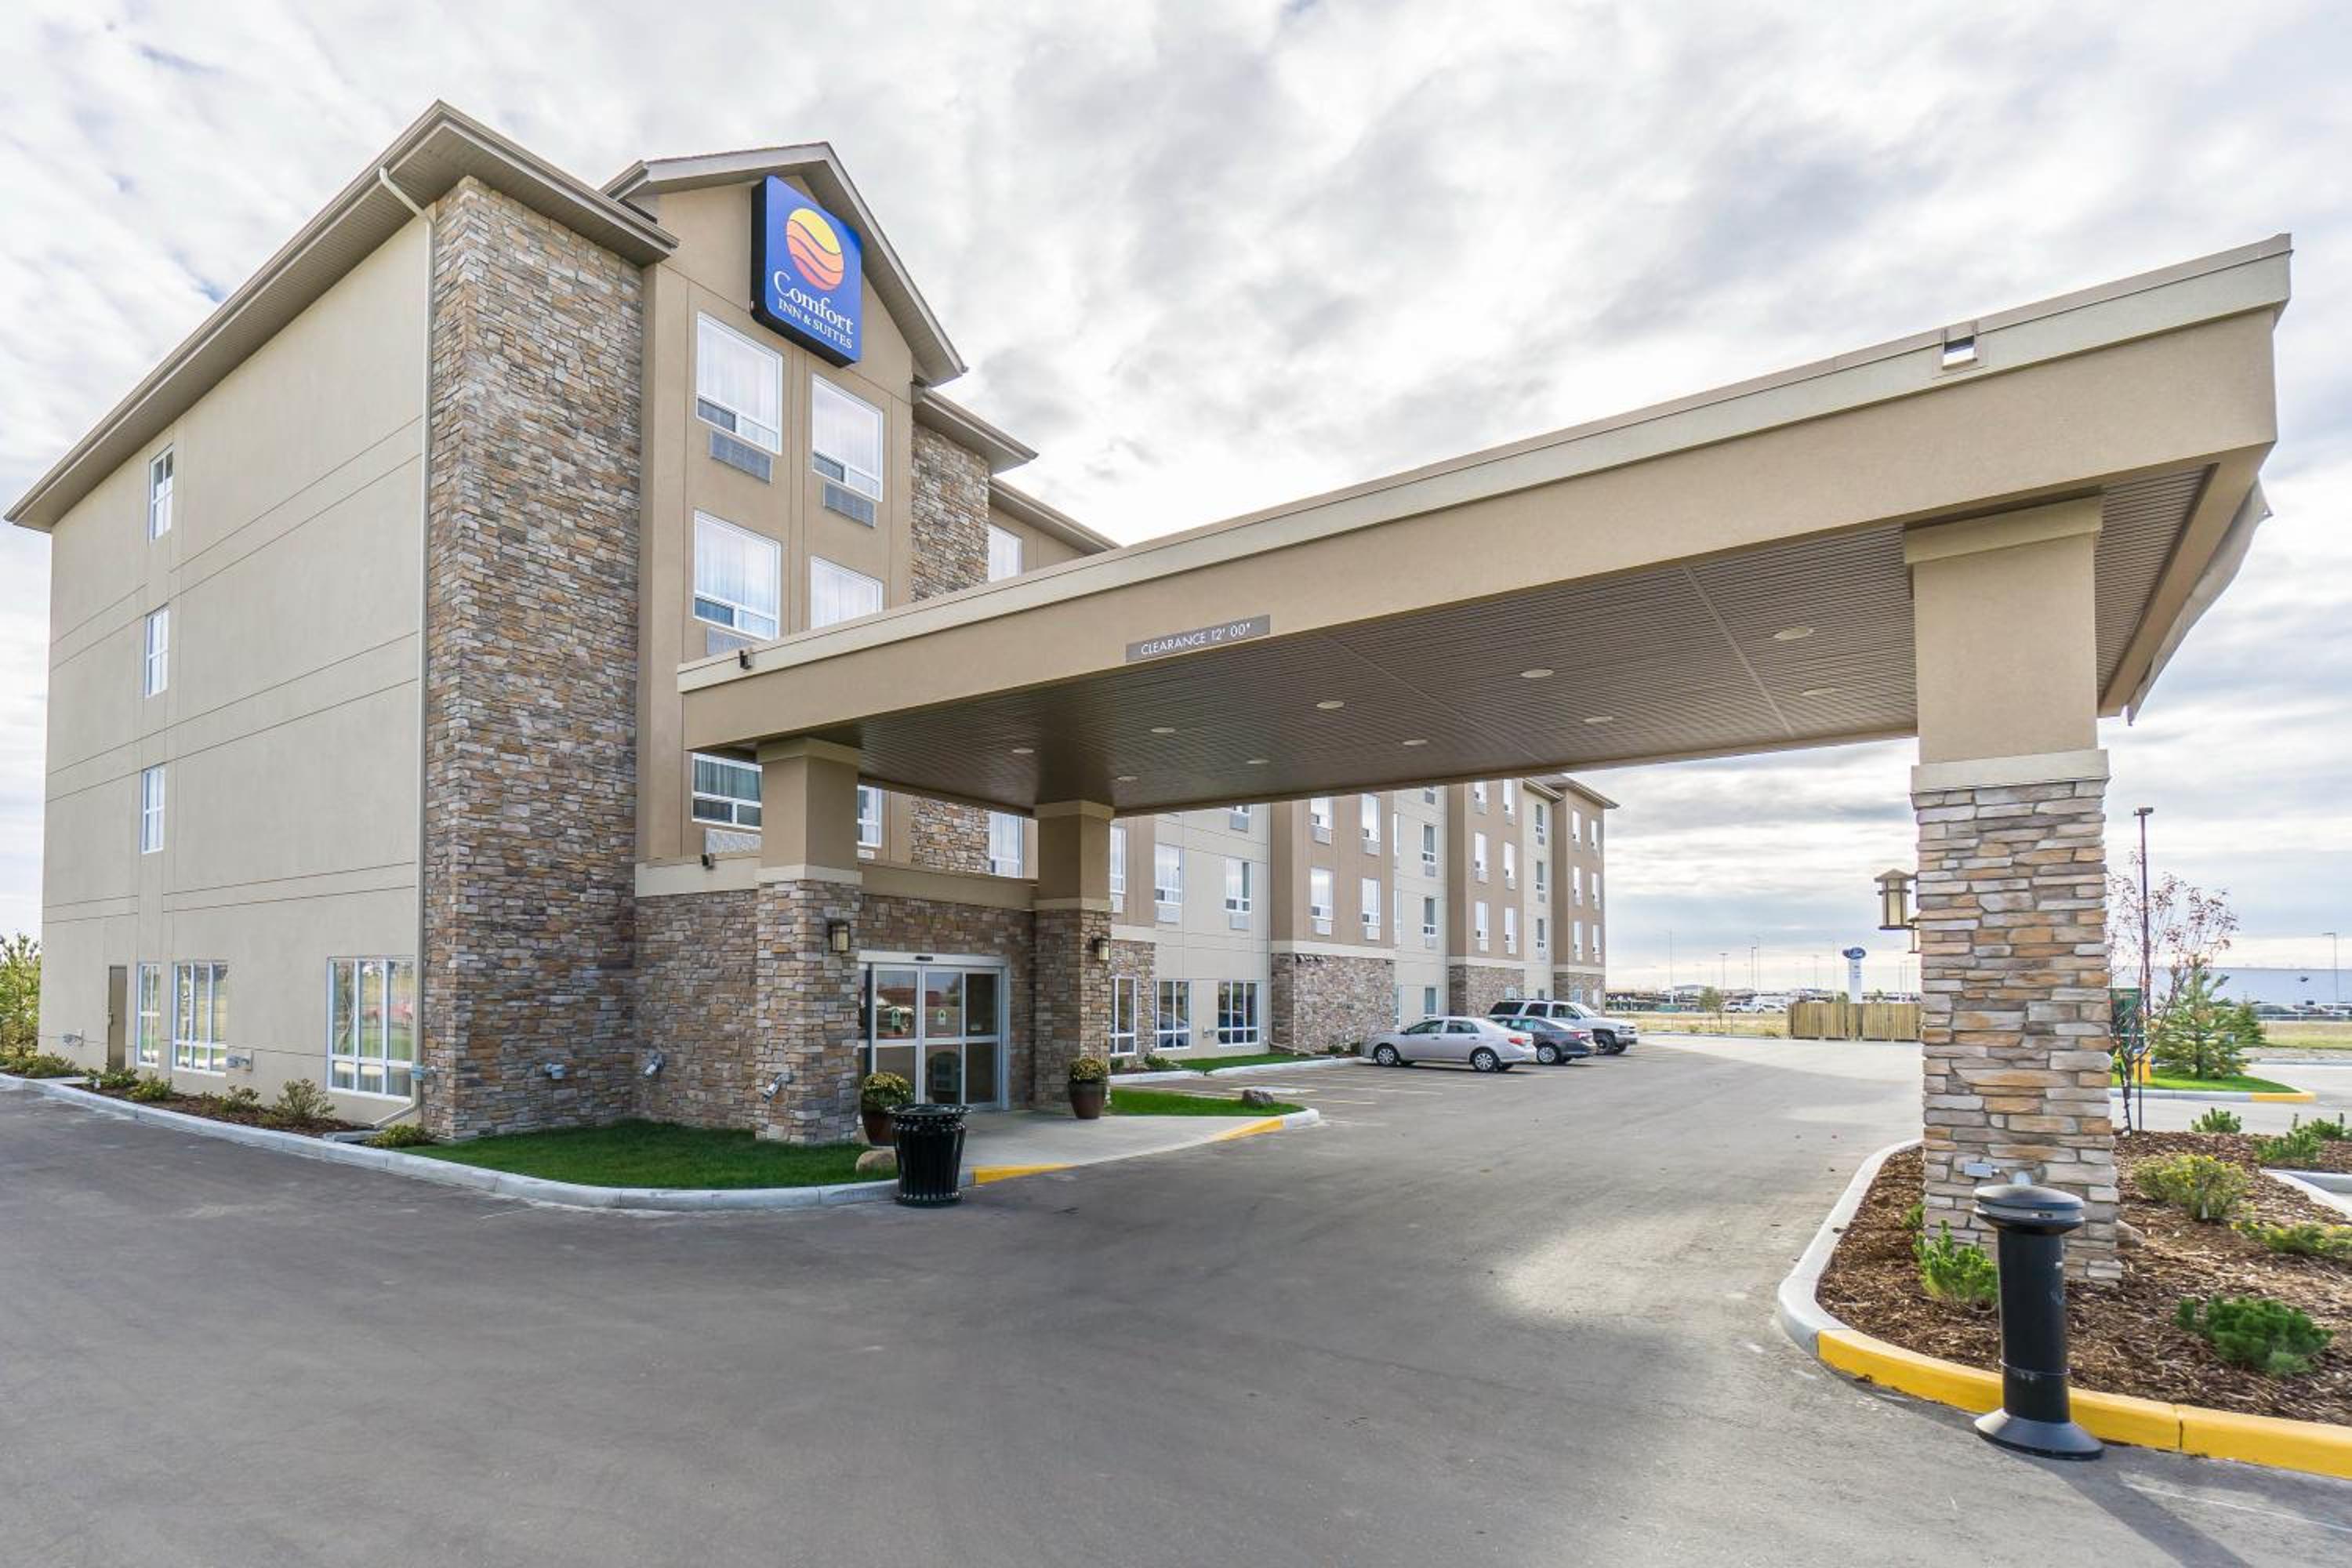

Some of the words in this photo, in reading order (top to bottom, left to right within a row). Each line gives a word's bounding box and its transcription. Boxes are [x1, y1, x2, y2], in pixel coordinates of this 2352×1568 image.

[774, 270, 854, 335] Comfort
[778, 297, 802, 321] INN
[803, 313, 812, 325] &
[813, 318, 853, 350] SUITES
[1141, 632, 1206, 655] CLEARANCE
